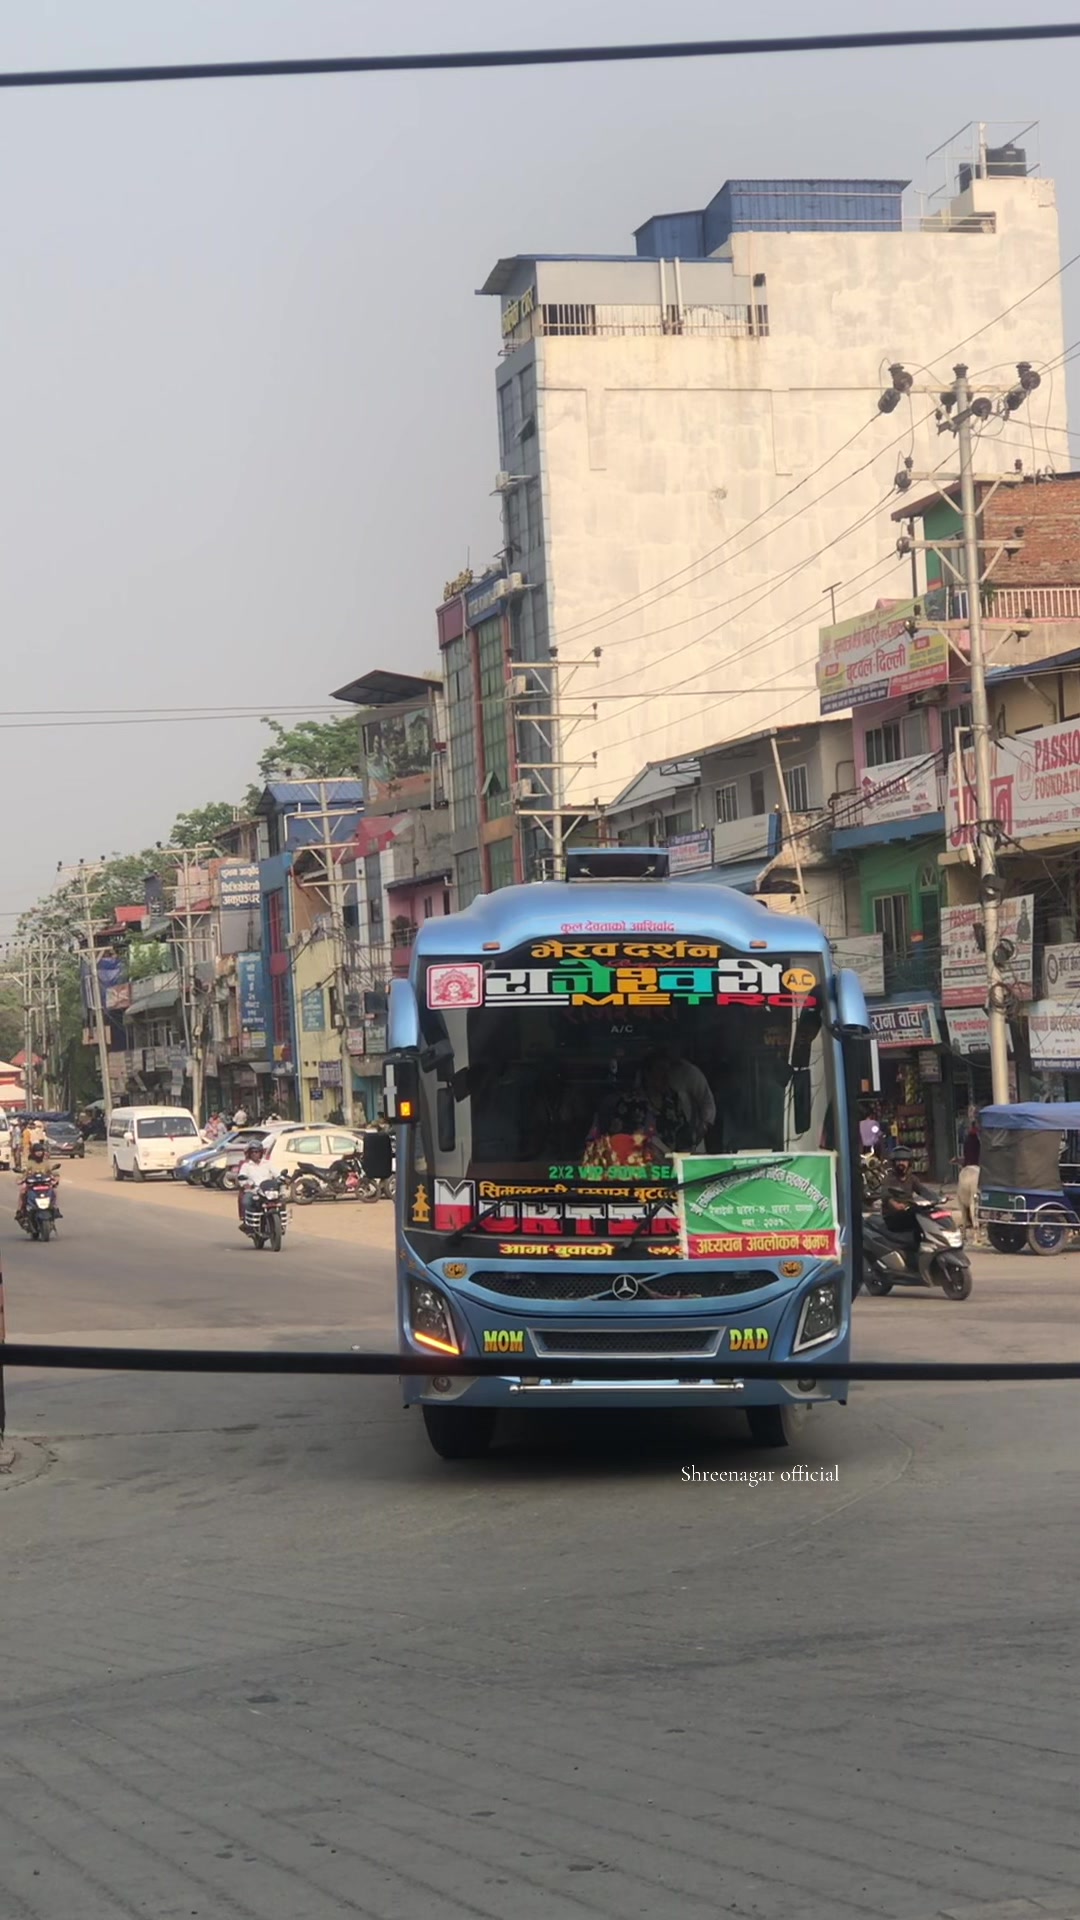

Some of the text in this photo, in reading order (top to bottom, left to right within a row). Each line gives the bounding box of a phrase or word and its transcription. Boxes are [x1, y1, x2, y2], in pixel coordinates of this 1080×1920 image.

[530, 939, 722, 959] भैरव दर्शन
[571, 993, 816, 1007] METRO
[746, 1232, 800, 1252] अवलोकन
[483, 1329, 524, 1353] MOM
[728, 1327, 770, 1352] DAD
